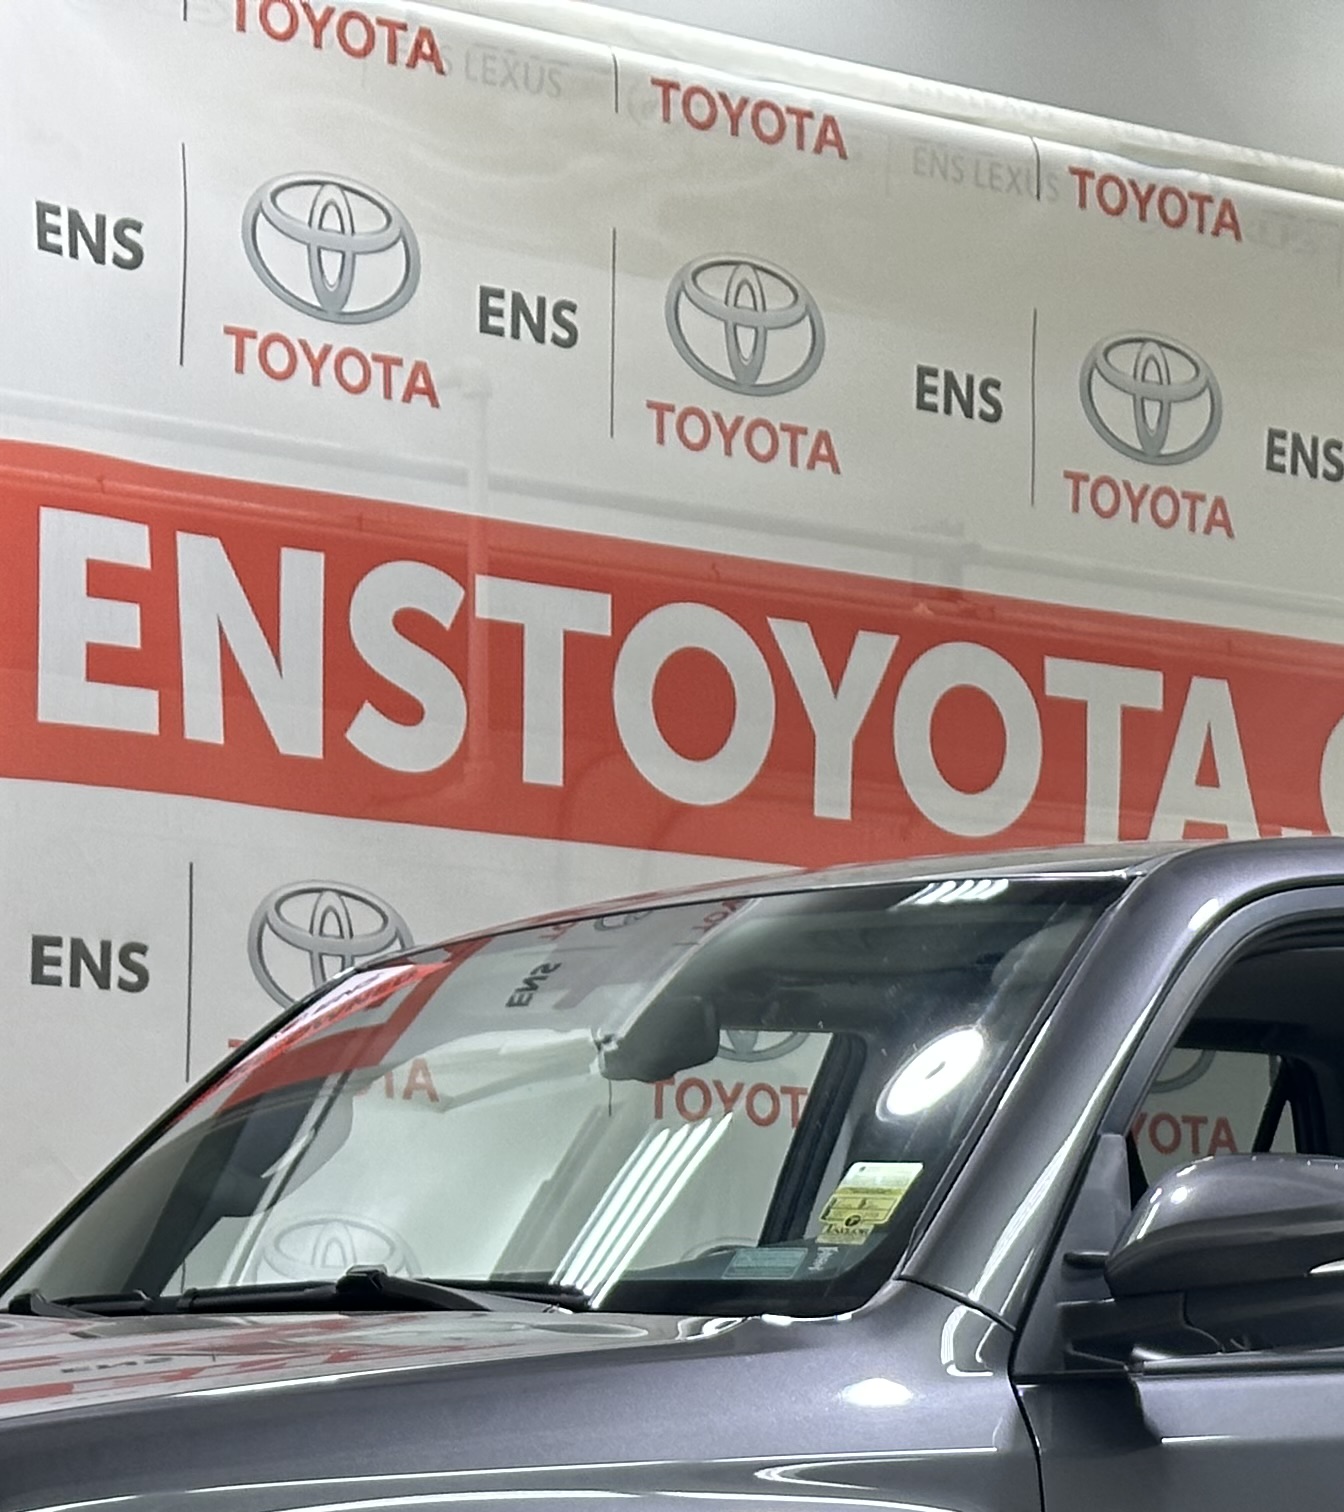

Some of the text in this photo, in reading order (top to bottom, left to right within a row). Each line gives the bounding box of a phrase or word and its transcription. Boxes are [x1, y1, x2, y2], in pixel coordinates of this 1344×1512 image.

[650, 77, 847, 158] TOYOTA
[36, 201, 144, 271] ENS
[1070, 165, 1242, 241] TOYOTA
[478, 285, 579, 349] ENS
[223, 324, 441, 409] TOYOTA
[915, 364, 1003, 424] ENS
[647, 399, 840, 474] TOYOTA
[1064, 470, 1234, 539] TOYOTA
[30, 933, 150, 994] ENS
[649, 1077, 808, 1128] TOYOT
